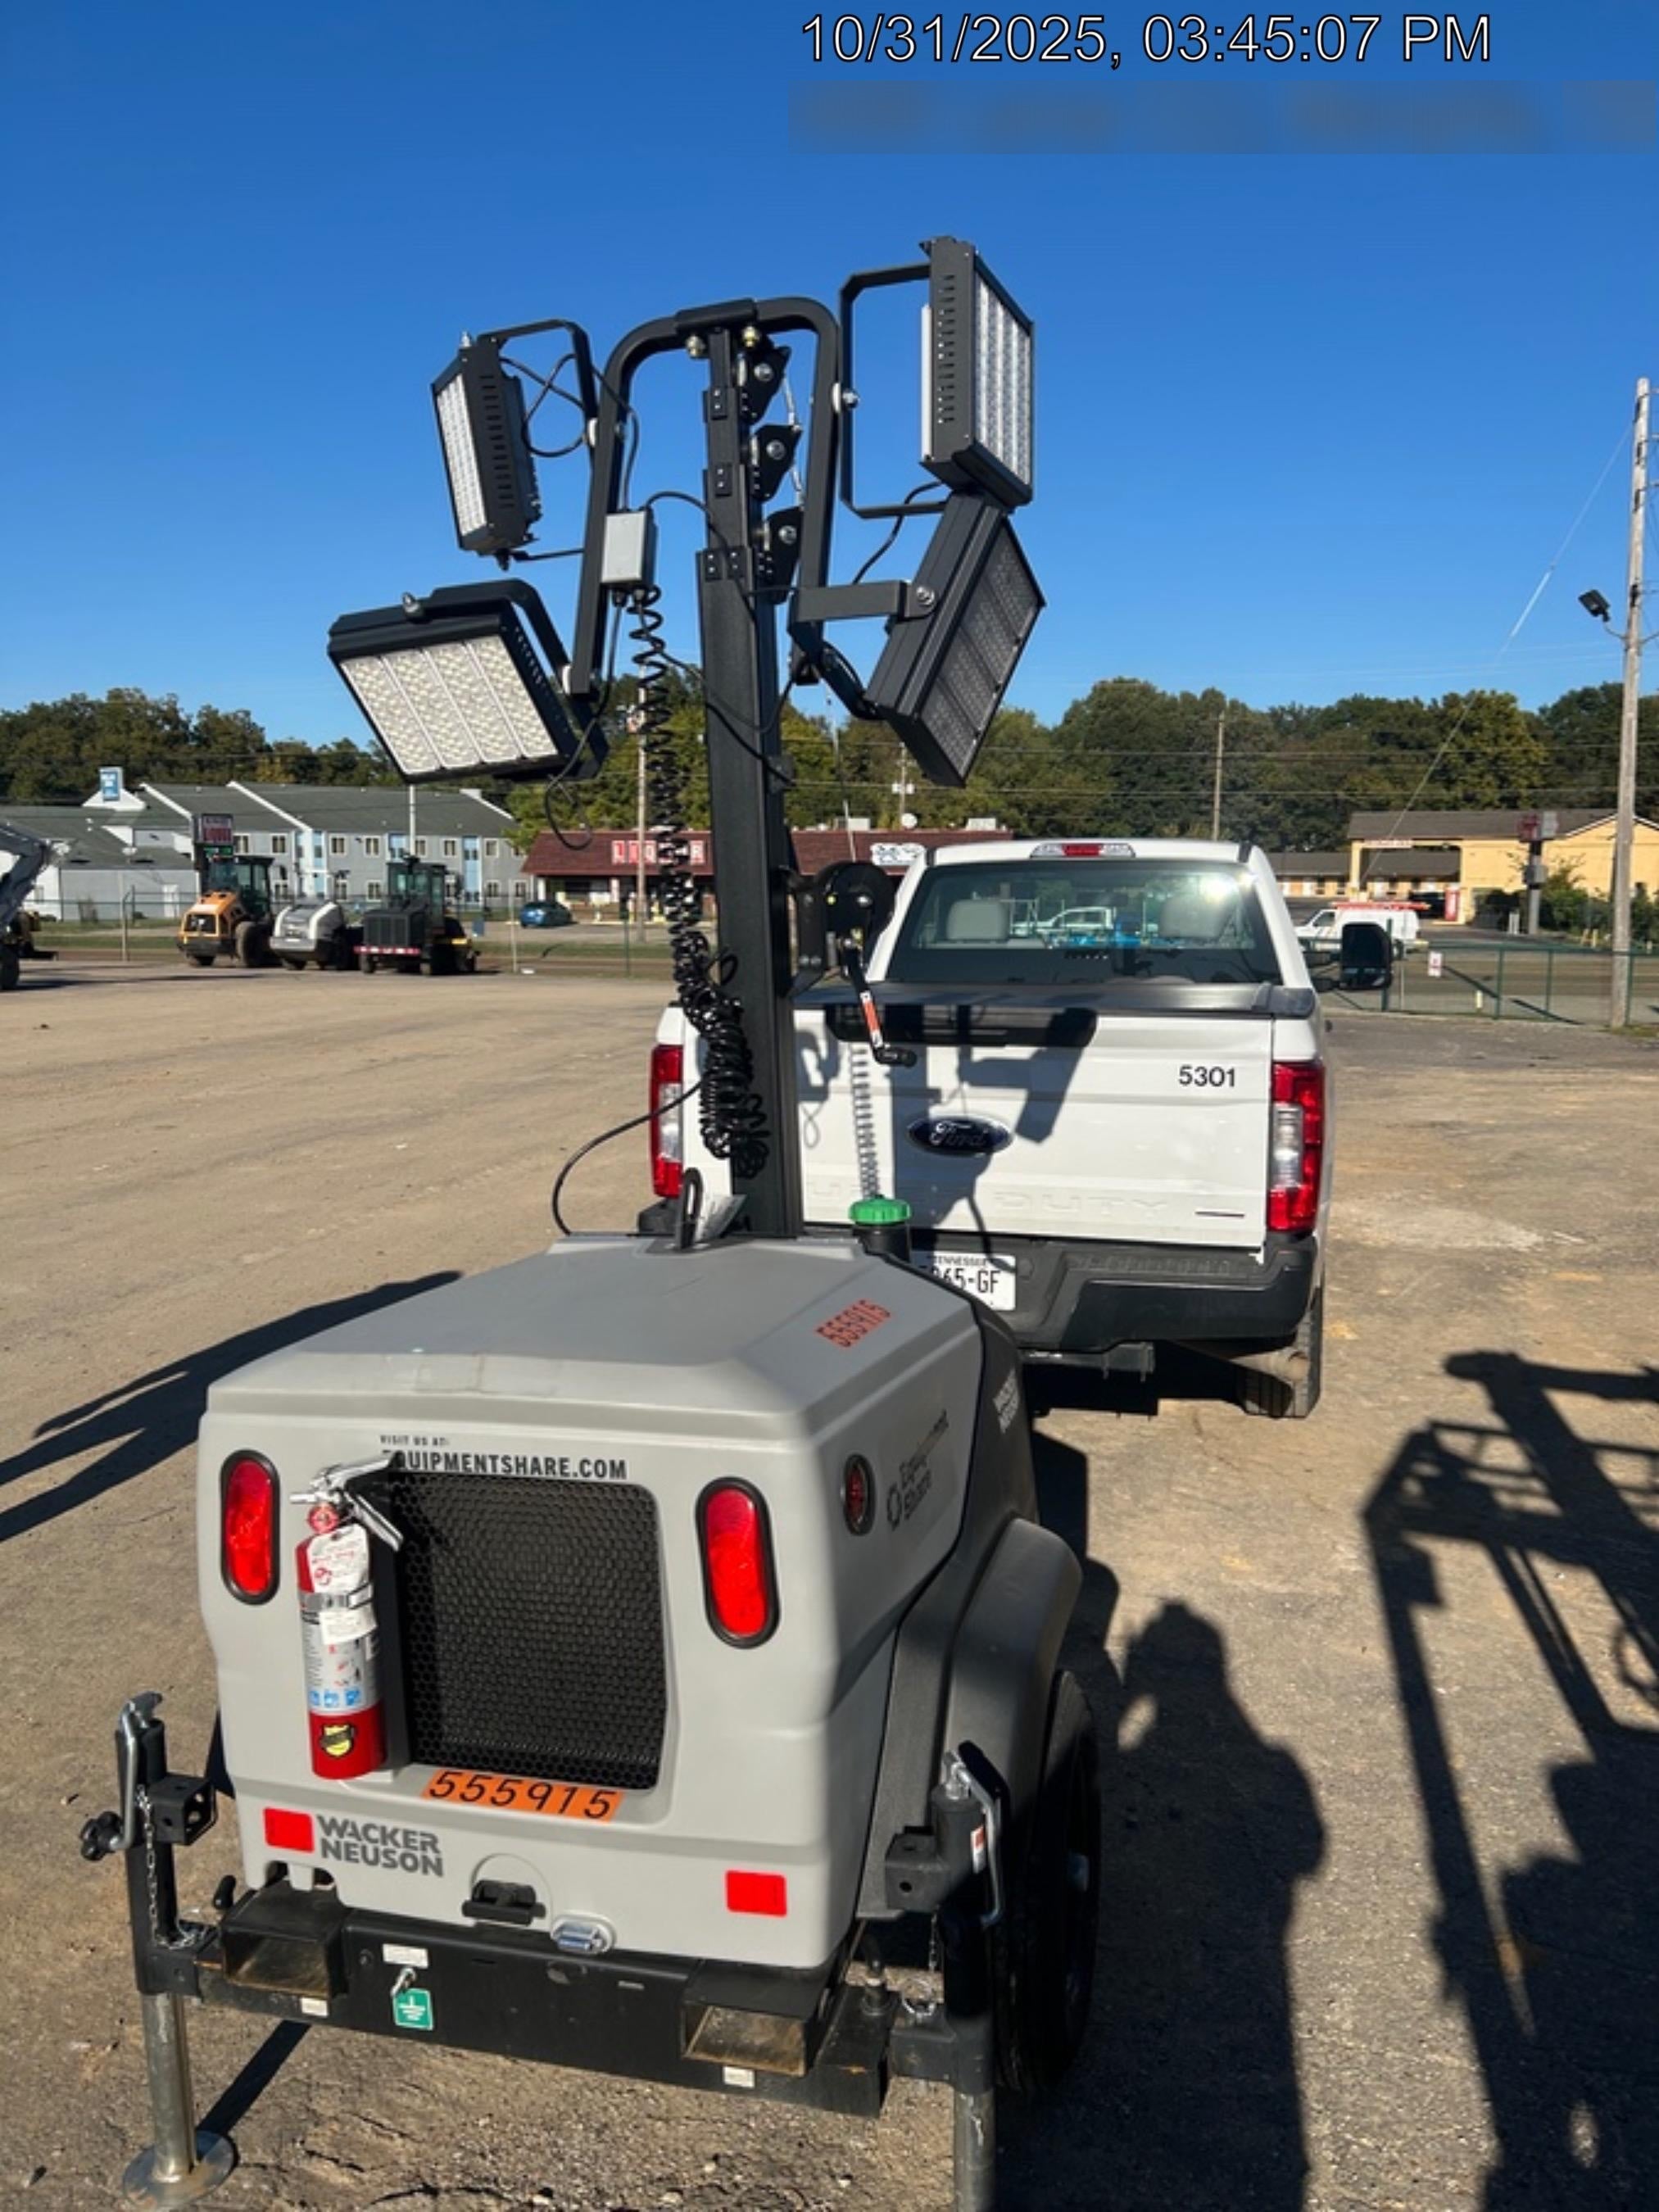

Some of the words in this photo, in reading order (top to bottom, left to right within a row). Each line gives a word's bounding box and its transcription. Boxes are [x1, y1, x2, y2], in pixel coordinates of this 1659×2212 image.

[1178, 1064, 1235, 1087] 5301
[382, 1448, 628, 1480] UIPMENTSHARE.COM
[429, 1770, 617, 1820] 555915
[316, 1814, 441, 1854] WACKER
[320, 1838, 444, 1877] NEUSON
